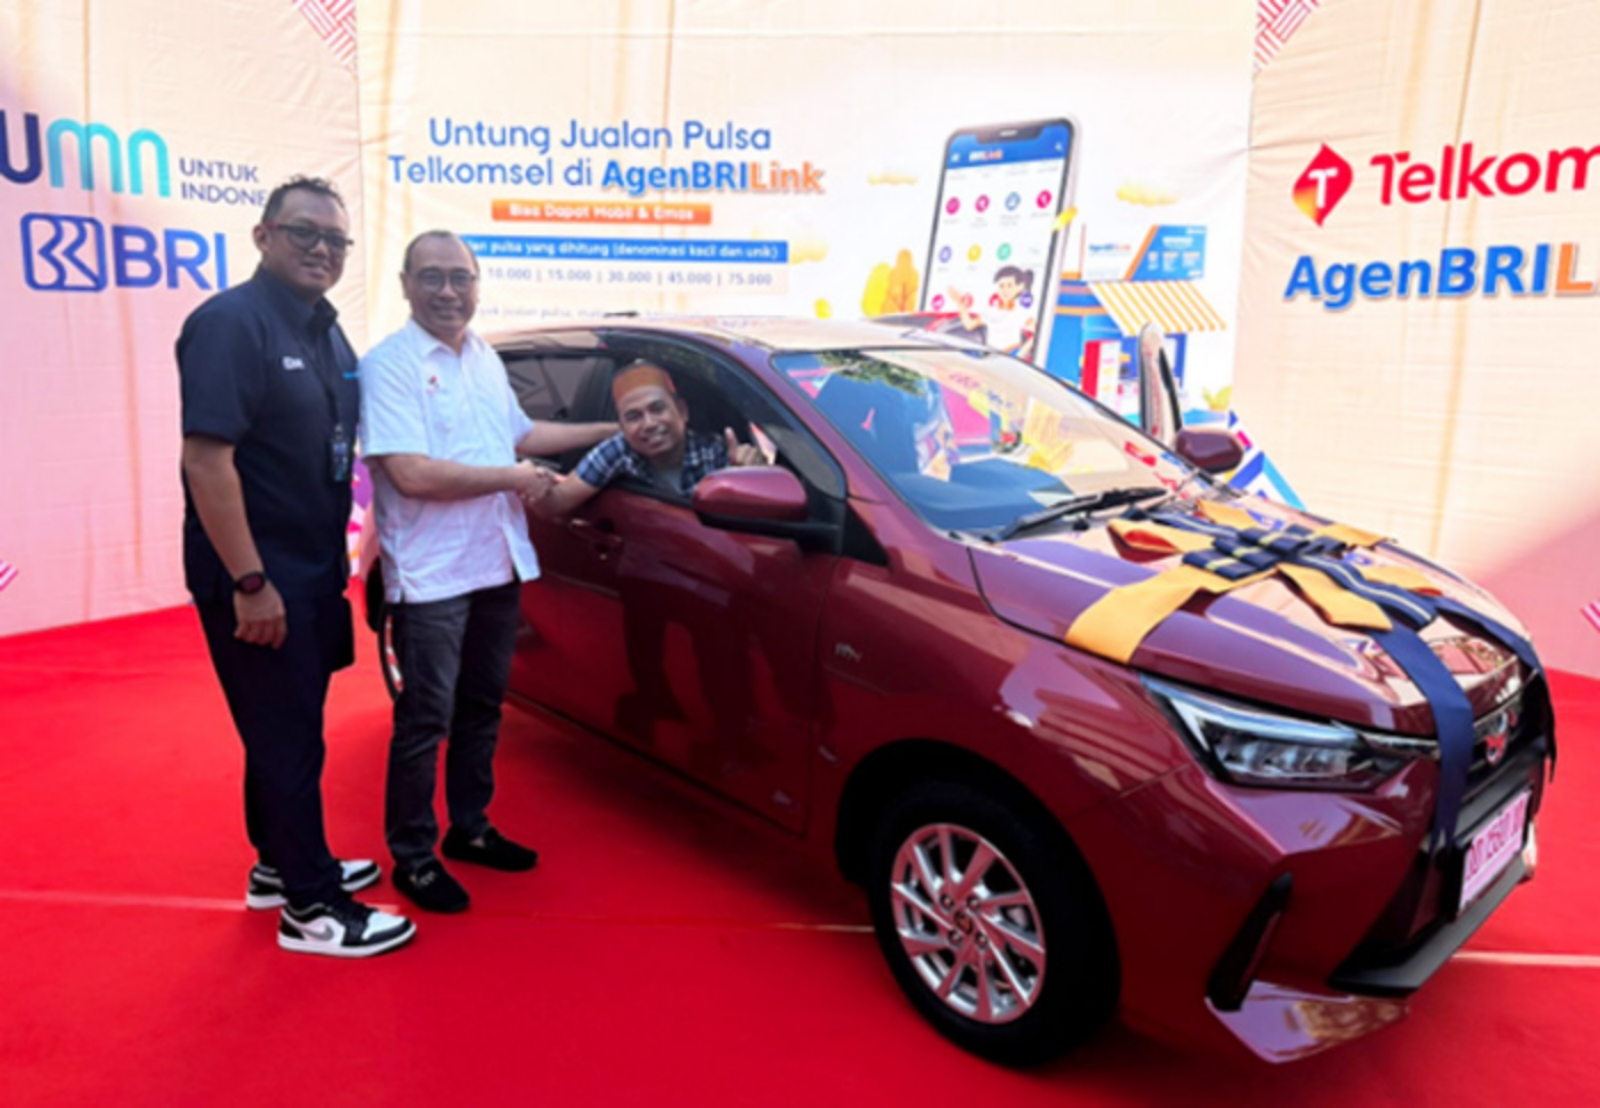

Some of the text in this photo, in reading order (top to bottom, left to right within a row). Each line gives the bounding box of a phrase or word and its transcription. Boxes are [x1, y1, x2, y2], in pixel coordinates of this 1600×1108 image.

[429, 118, 772, 153] Untung Jualan Pulsa
[179, 156, 259, 183] UNTUK
[388, 155, 825, 196] Telkomsel di AgenBRILink
[1369, 142, 1600, 205] Telkom
[509, 203, 694, 221] Bisa Dapat Mobil & Emas
[111, 225, 229, 292] BRI
[490, 240, 522, 255] pulsa
[526, 243, 556, 257] yang
[559, 241, 609, 257] dihitung
[720, 245, 743, 258] dan
[488, 268, 772, 286] 10.000 15.000 30.000 45.000 75.000
[1283, 242, 1594, 311] AgenBRIL
